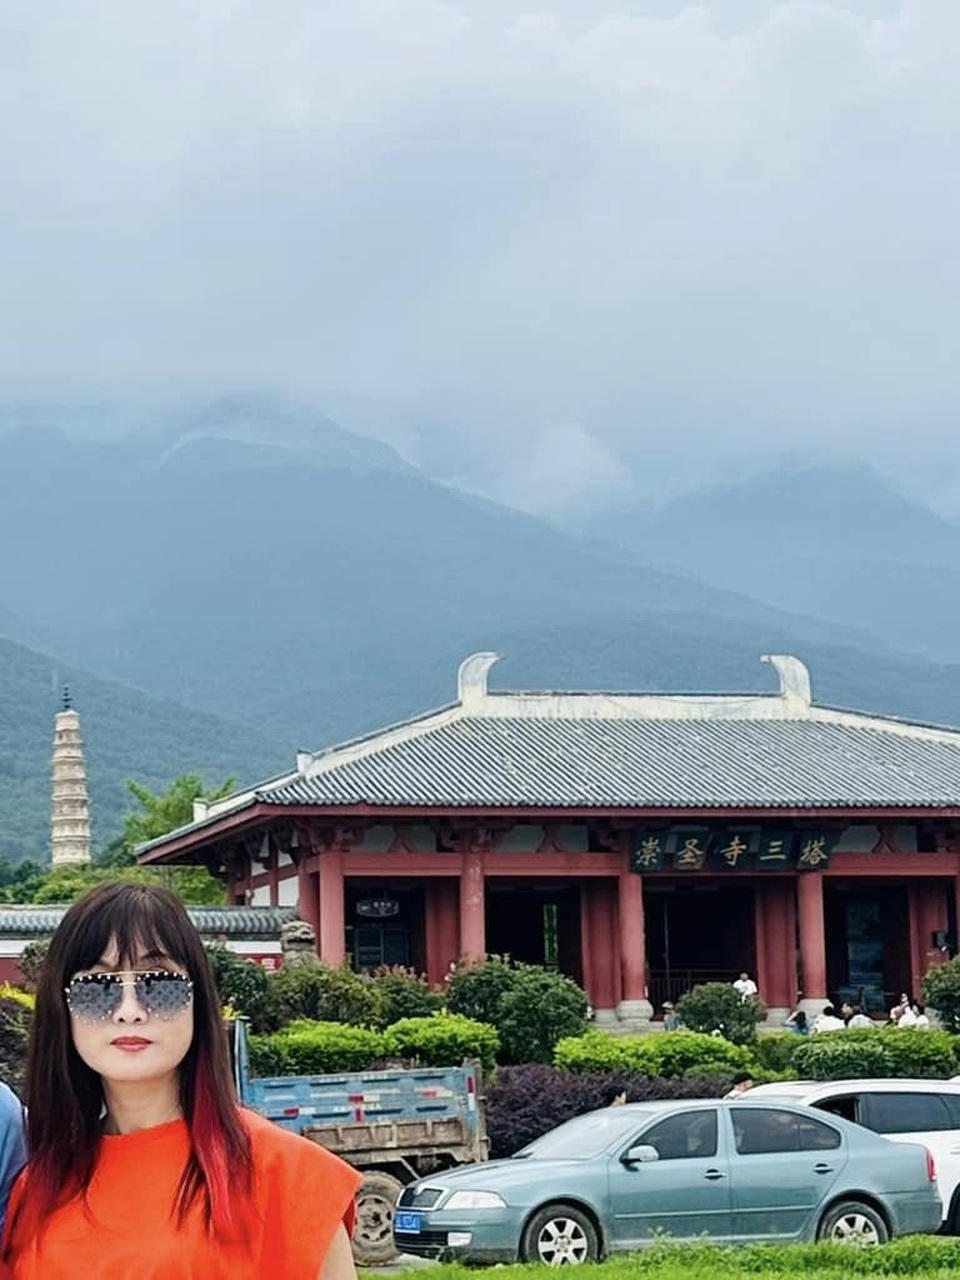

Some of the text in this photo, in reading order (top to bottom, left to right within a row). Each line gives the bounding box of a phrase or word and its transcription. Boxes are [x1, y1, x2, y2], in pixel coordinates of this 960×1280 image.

[635, 835, 828, 866] 崇圣寺三塔
